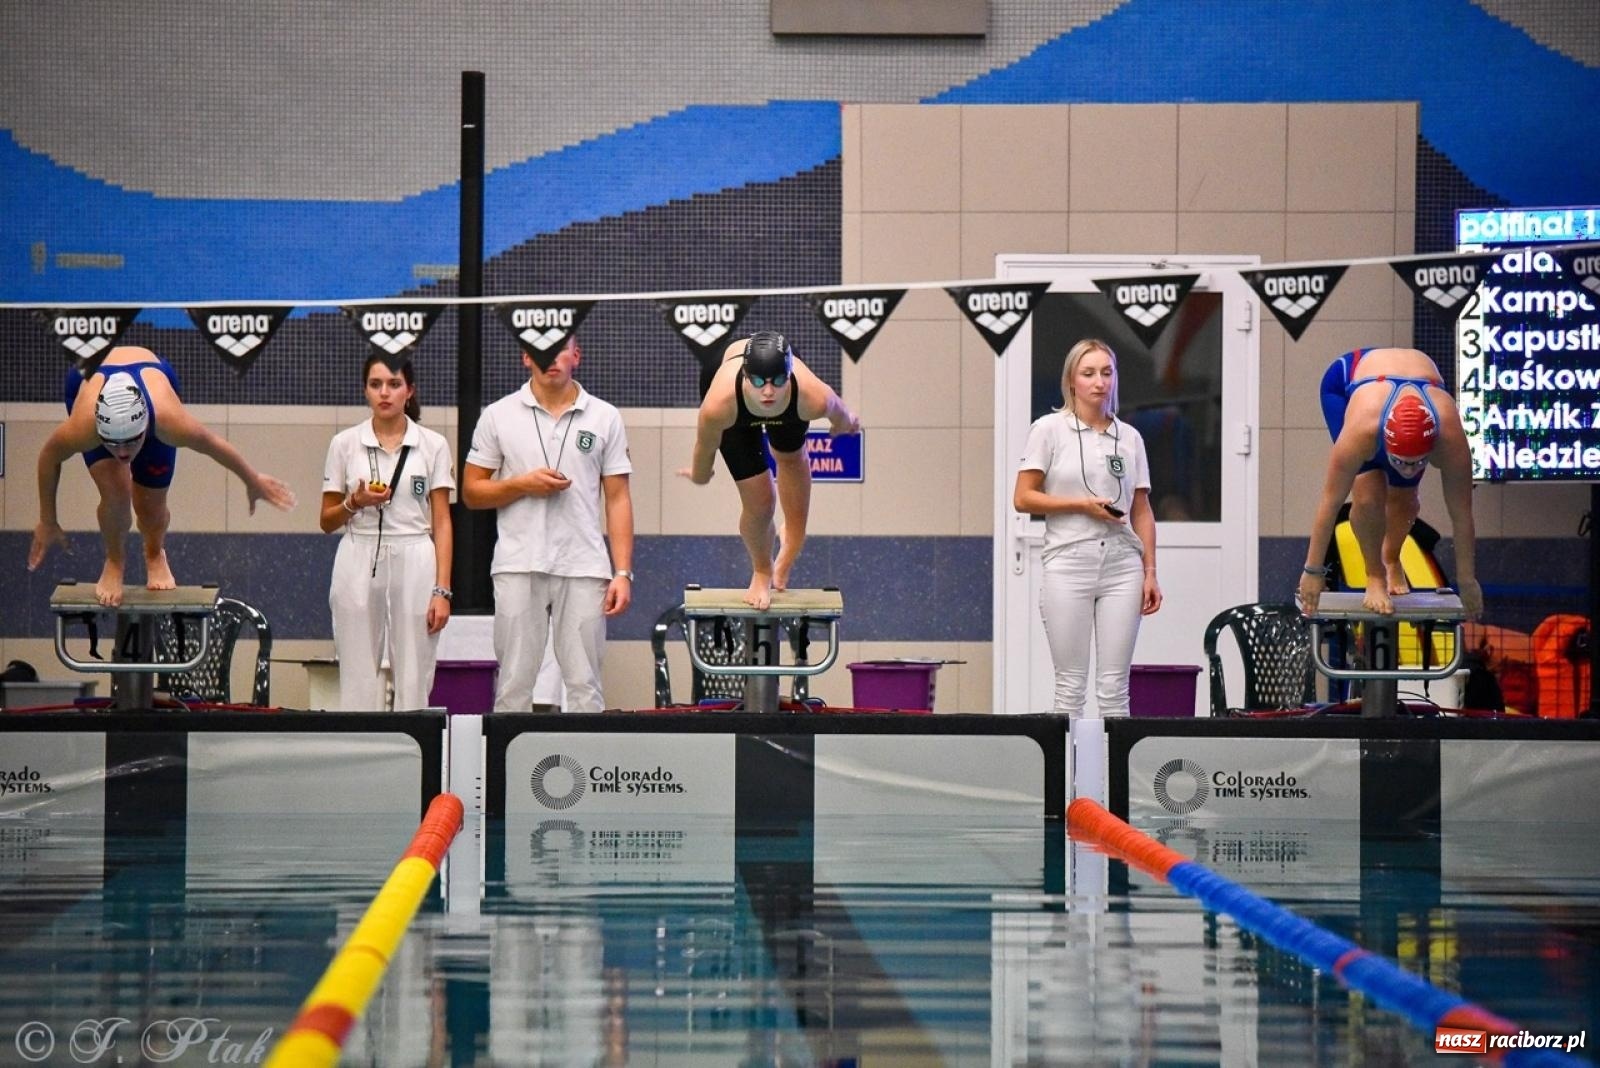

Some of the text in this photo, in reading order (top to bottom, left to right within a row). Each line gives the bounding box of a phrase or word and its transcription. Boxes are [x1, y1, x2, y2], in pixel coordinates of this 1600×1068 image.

[1585, 209, 1596, 235] 1
[1265, 274, 1324, 296] arena
[1415, 265, 1475, 286] arena
[968, 291, 1028, 311] arena
[1116, 284, 1177, 304] arena
[674, 303, 735, 323] arena
[824, 298, 884, 318] arena
[1461, 292, 1480, 319] 2
[54, 316, 117, 335] arena
[208, 314, 270, 334] arena
[362, 312, 423, 332] arena
[512, 308, 573, 327] arena
[1462, 329, 1481, 358] 3
[1461, 368, 1480, 397] 4
[1464, 407, 1480, 436] 5
[1484, 401, 1581, 430] Artwik
[811, 458, 844, 472] ANIA
[120, 622, 141, 661] 4
[752, 624, 772, 666] 5
[1370, 626, 1390, 671] 6
[590, 782, 622, 793] TIME
[1213, 787, 1245, 798] TIME
